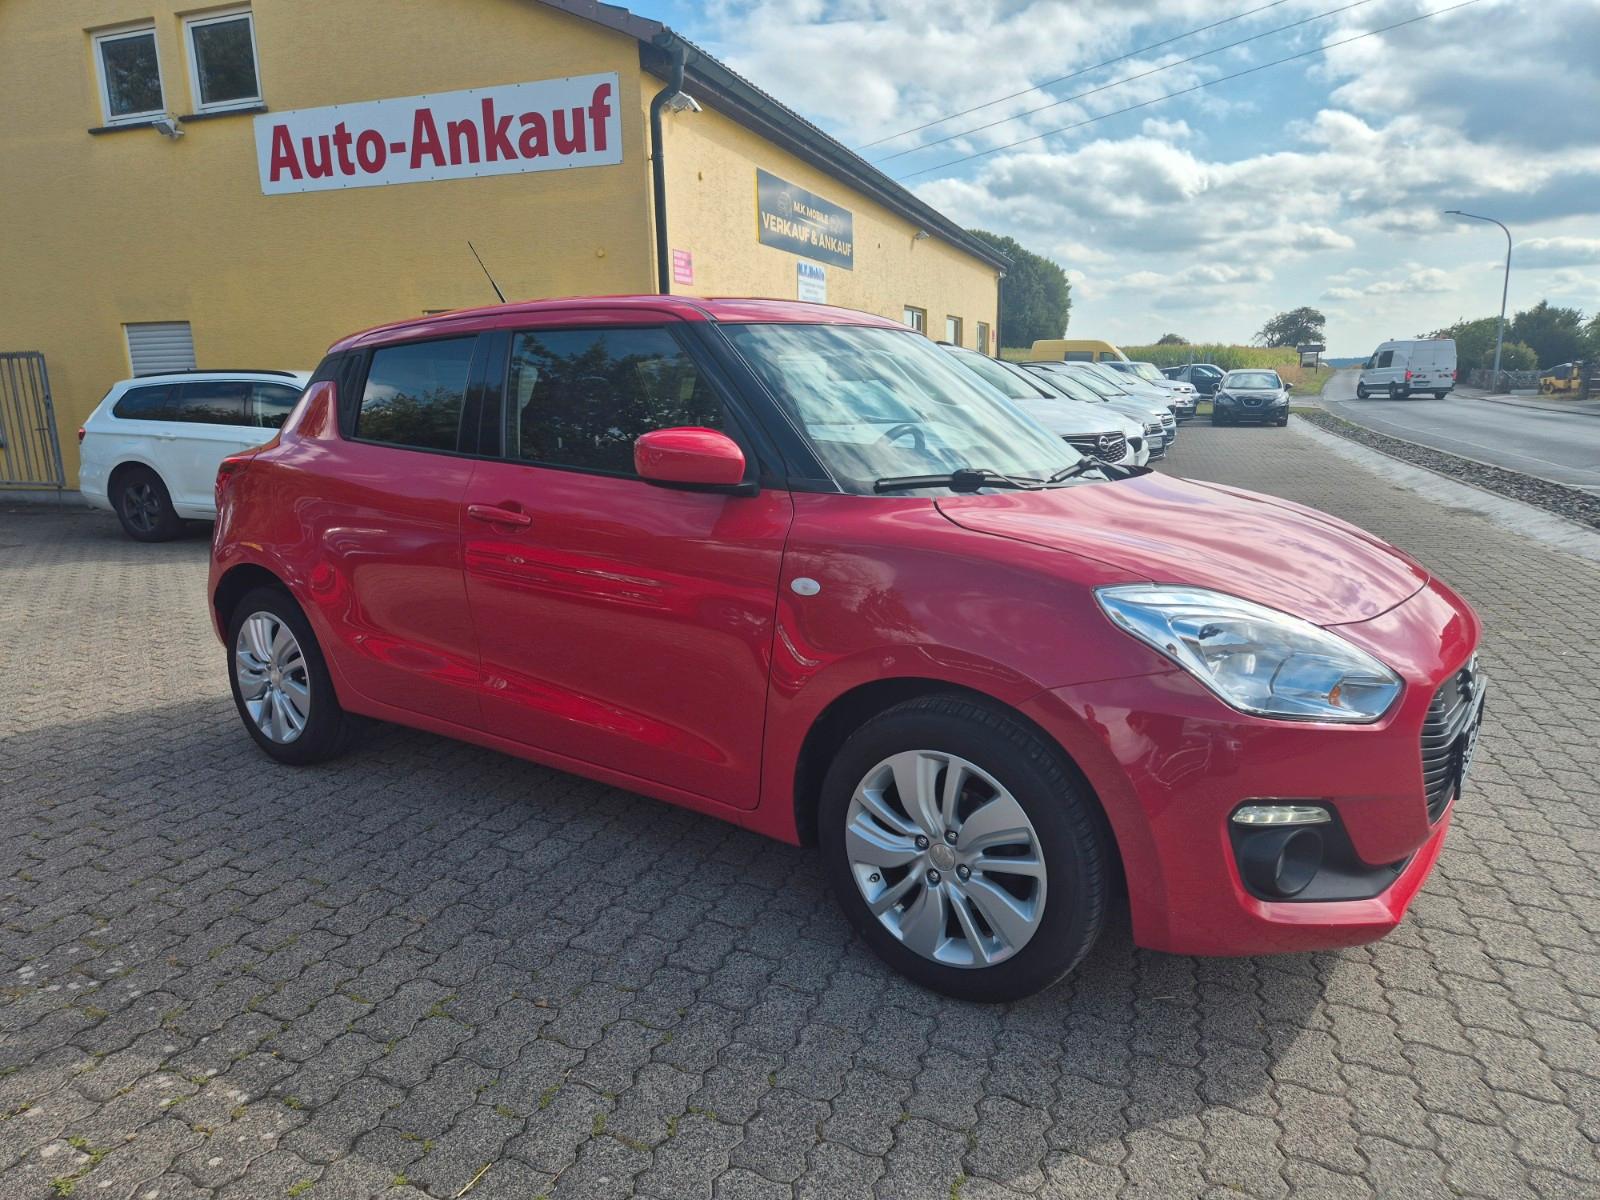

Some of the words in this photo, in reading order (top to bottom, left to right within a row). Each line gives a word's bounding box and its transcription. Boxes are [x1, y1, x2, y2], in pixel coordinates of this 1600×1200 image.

[269, 83, 611, 182] Auto-Ankauf
[762, 211, 810, 242] VERKAUF
[811, 230, 817, 246] &
[819, 234, 851, 256] ANKAUF
